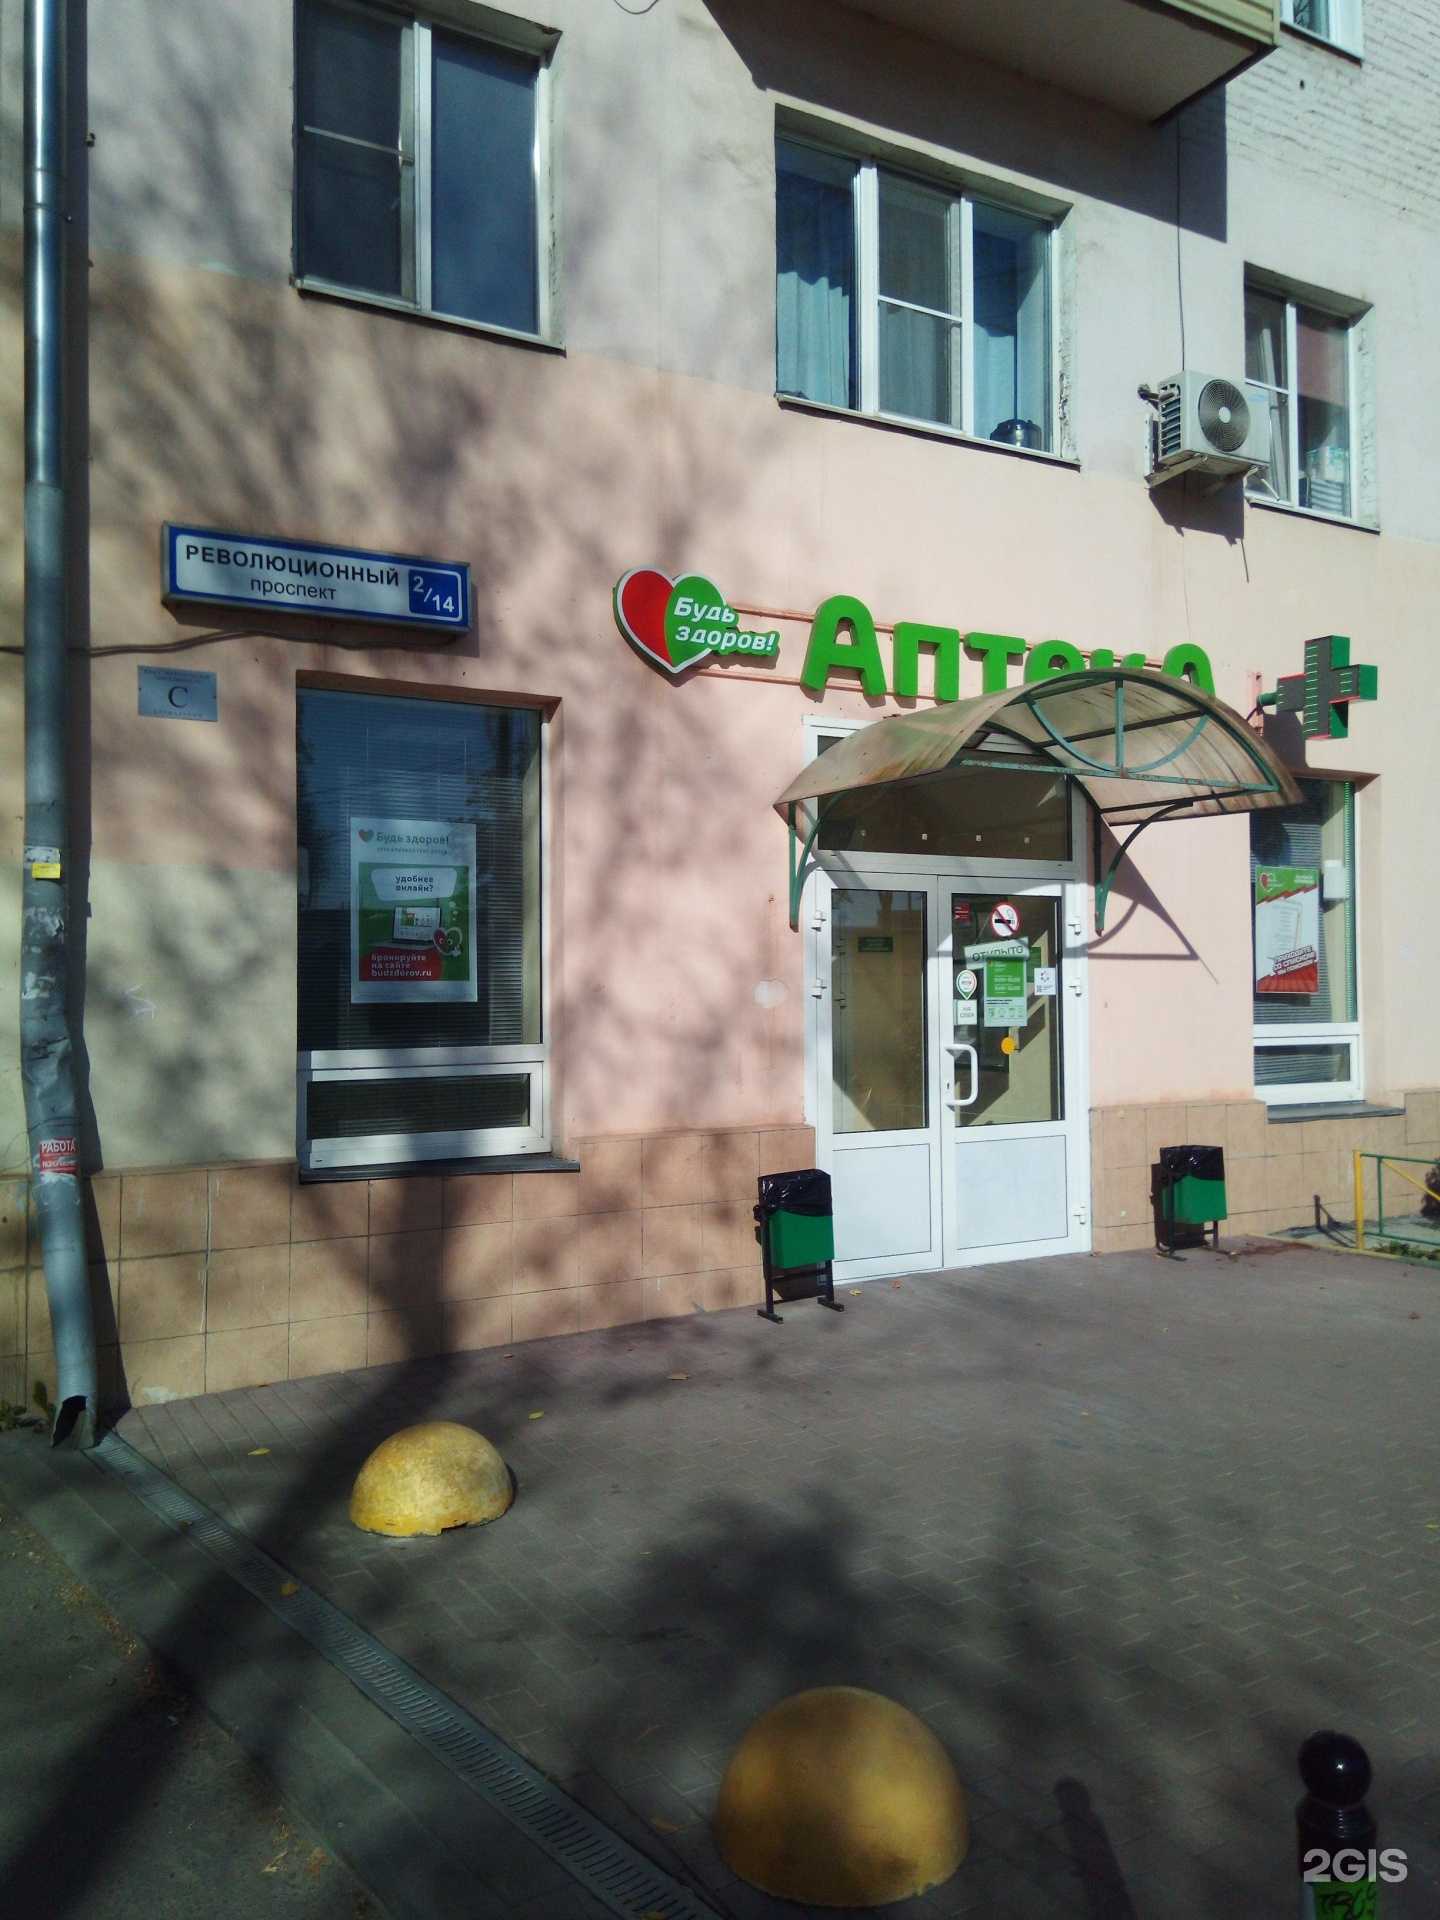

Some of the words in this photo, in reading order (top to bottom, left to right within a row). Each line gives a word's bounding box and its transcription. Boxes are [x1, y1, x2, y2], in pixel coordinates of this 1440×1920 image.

[186, 544, 400, 587] РЕВОЛЮЦИОННЫЙ
[412, 575, 455, 613] 2/14
[250, 577, 337, 601] проспект
[674, 597, 736, 623] Будь
[675, 626, 776, 651] здоров!
[41, 1139, 77, 1153] РАБОТА
